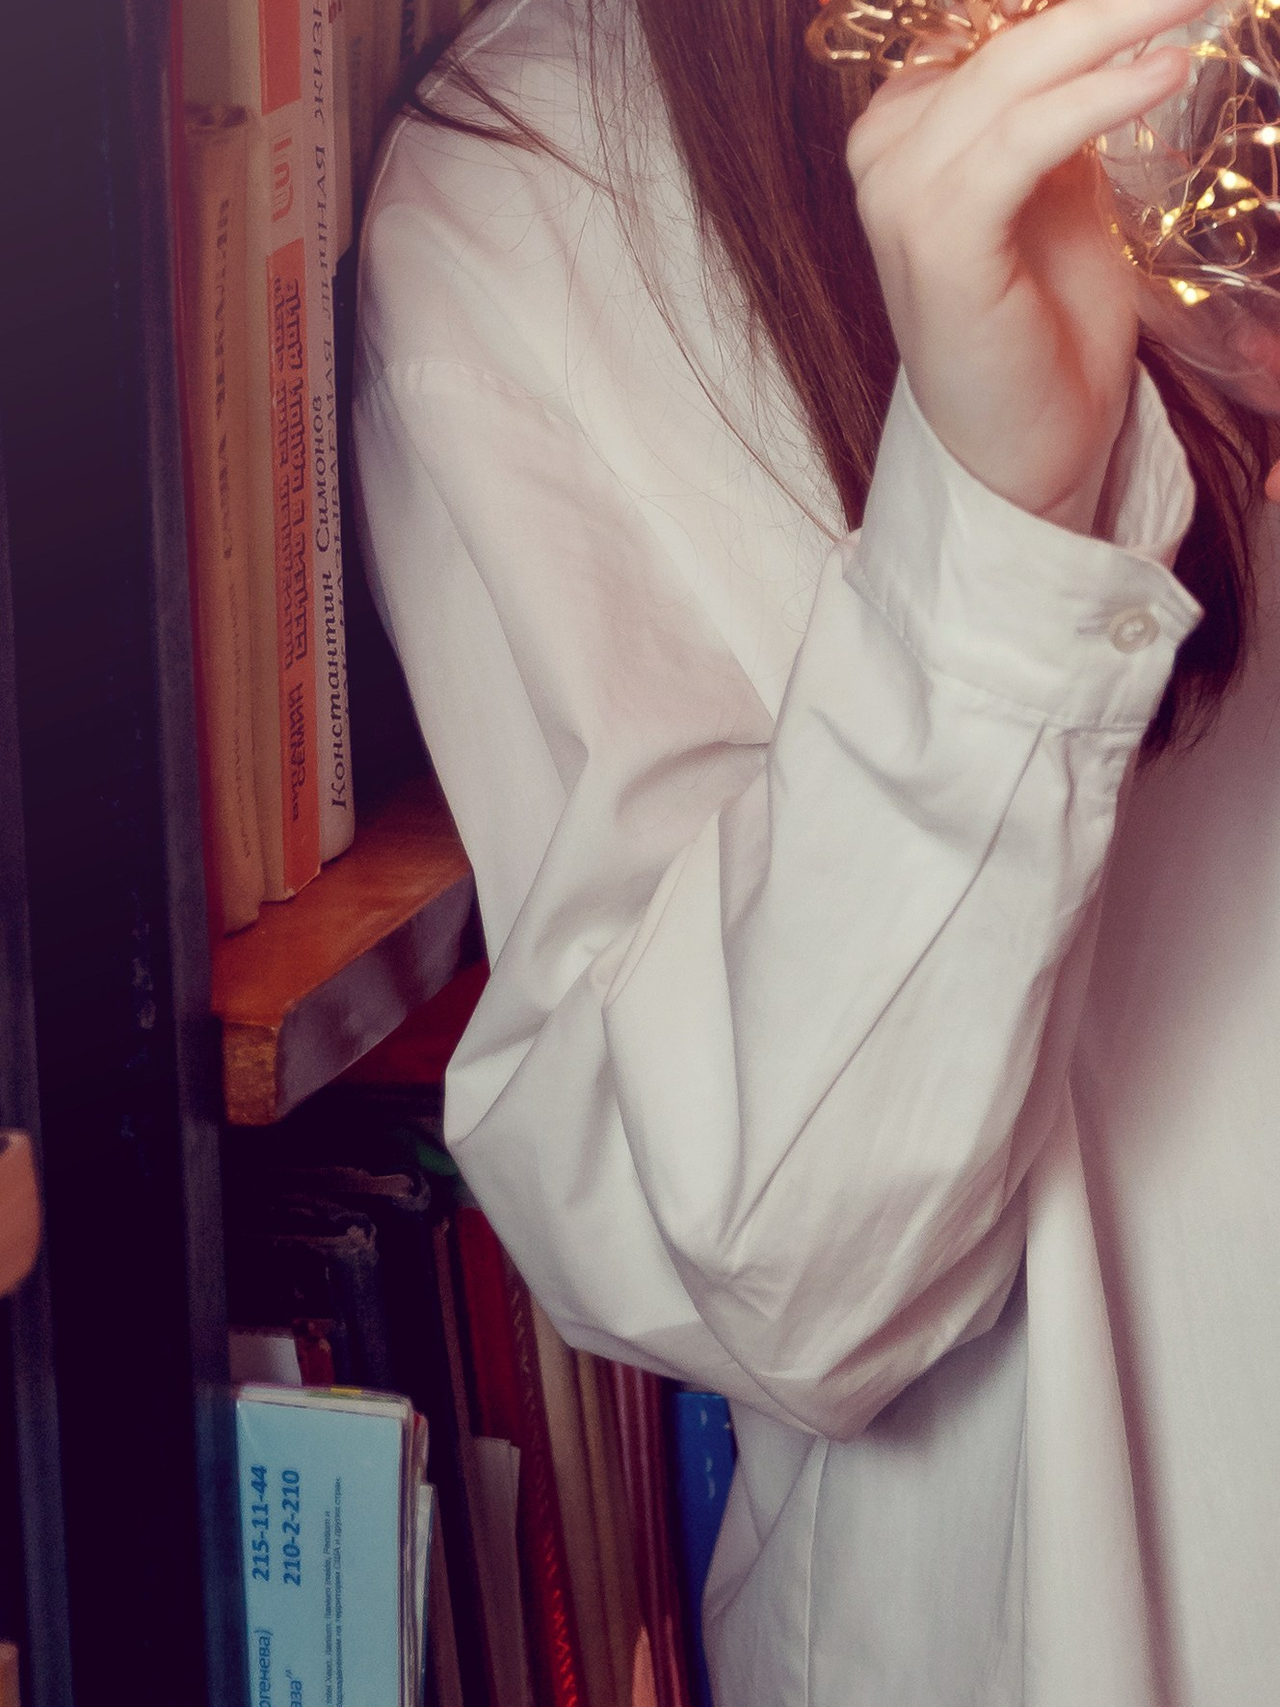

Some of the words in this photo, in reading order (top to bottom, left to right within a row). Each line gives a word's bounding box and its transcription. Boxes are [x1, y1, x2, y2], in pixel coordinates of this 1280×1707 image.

[315, 146, 331, 321] ЛИЧНАЯ
[312, 395, 331, 553] Симонов
[321, 571, 348, 811] Константин
[250, 1465, 270, 1582] 215-11-44
[281, 1469, 301, 1586] 210-2-210
